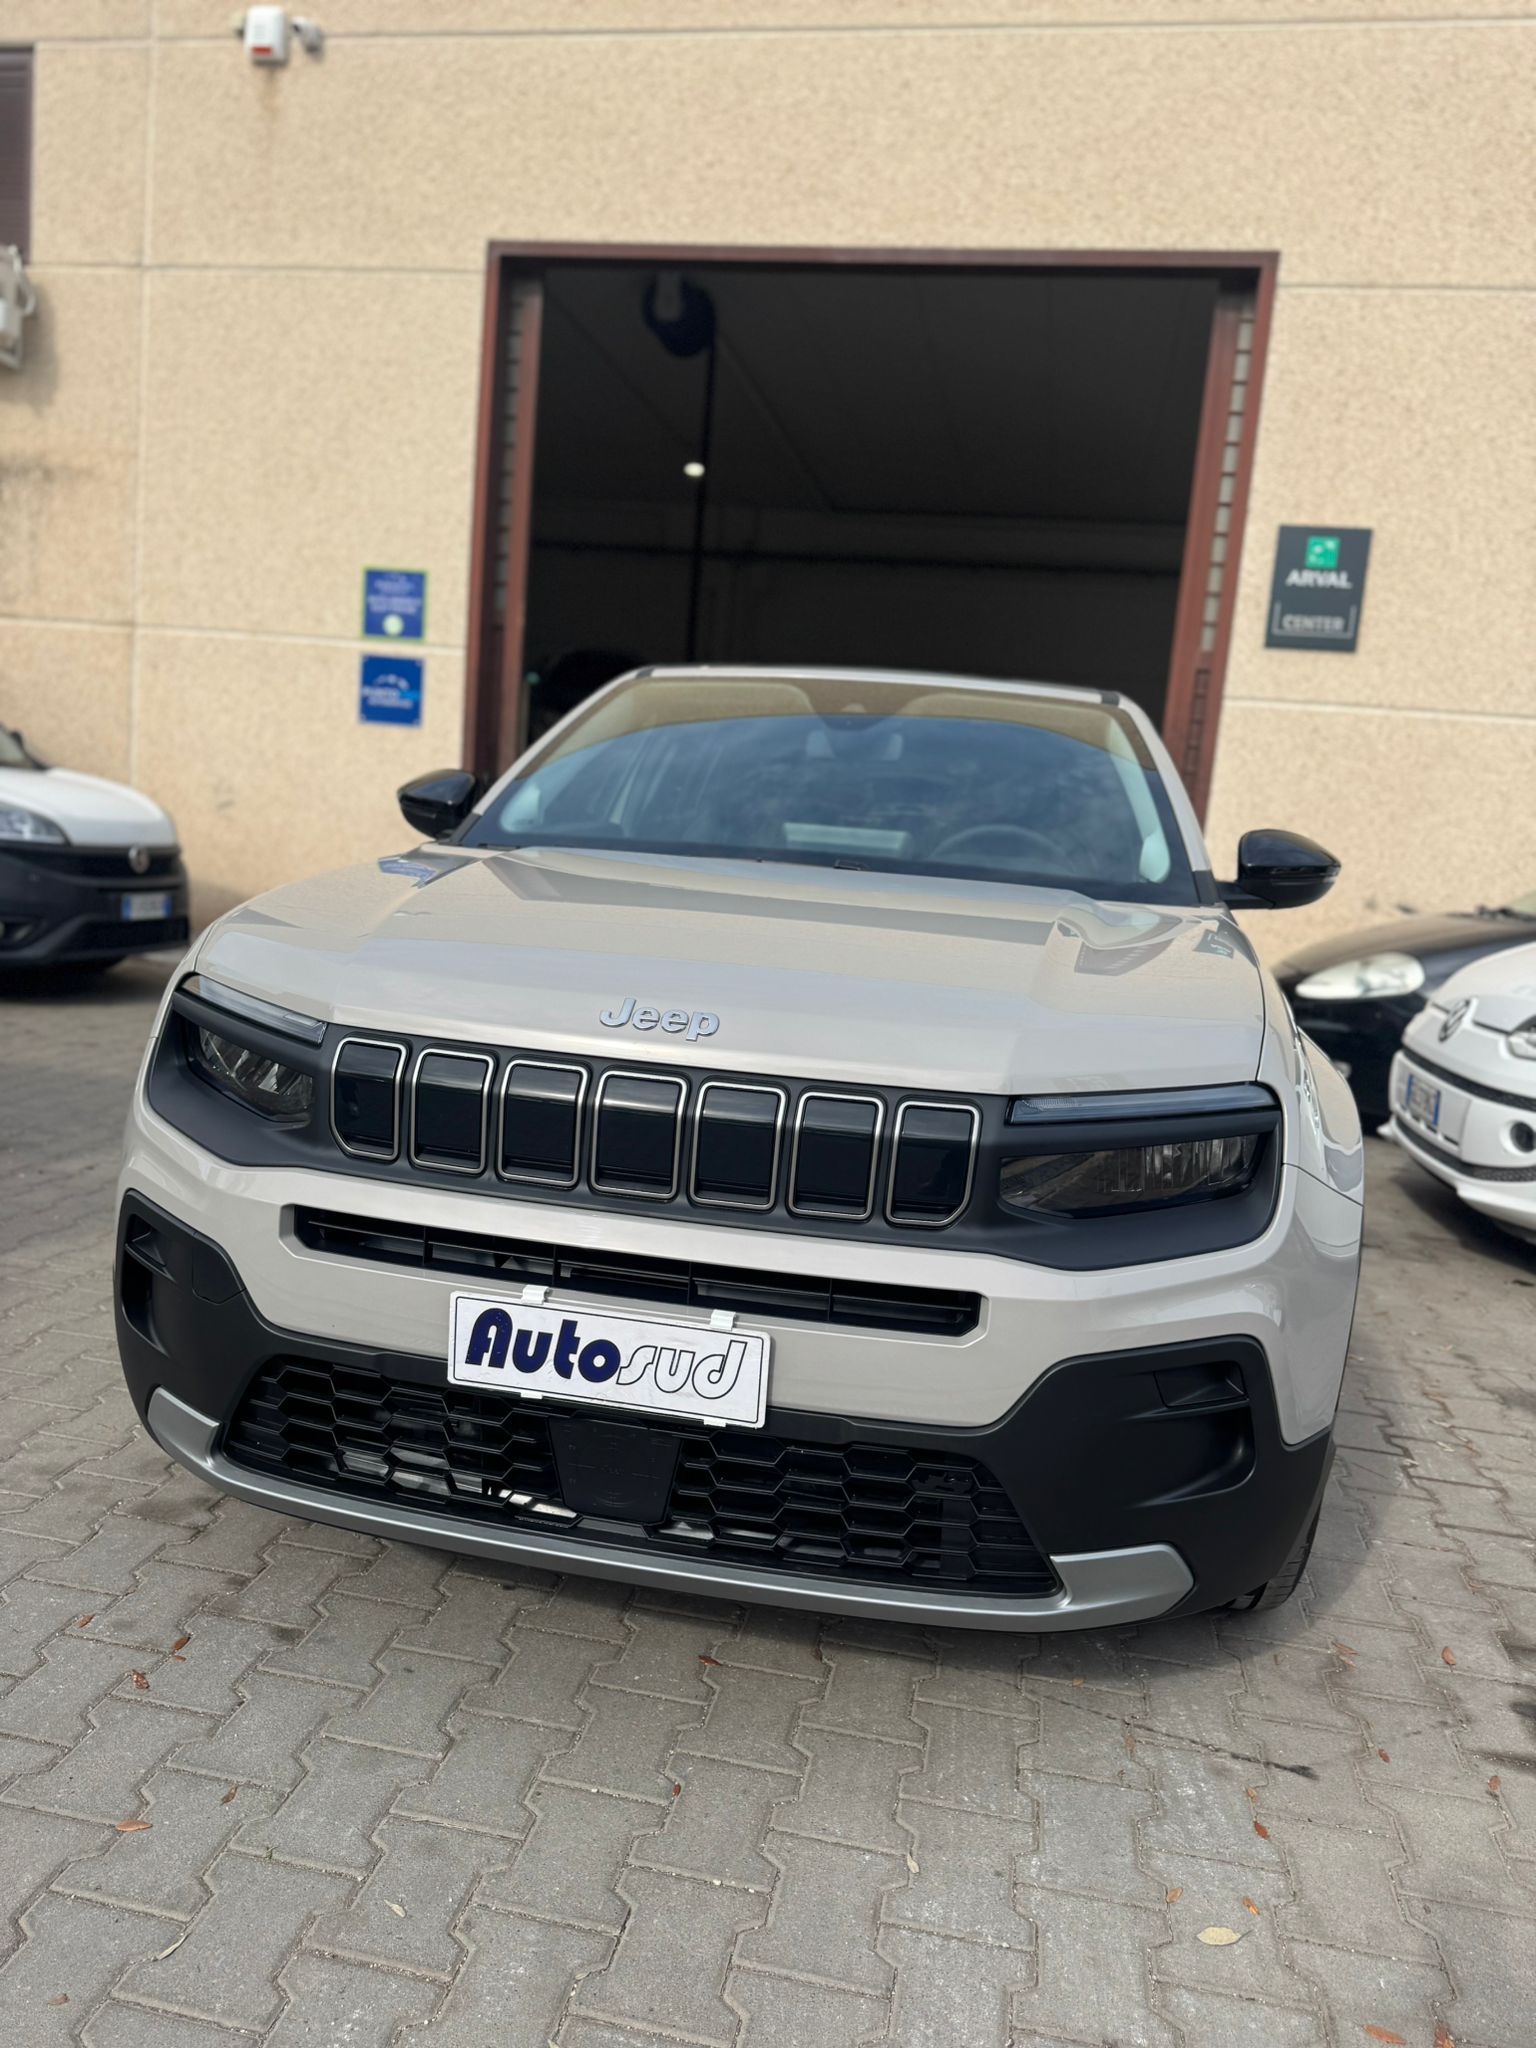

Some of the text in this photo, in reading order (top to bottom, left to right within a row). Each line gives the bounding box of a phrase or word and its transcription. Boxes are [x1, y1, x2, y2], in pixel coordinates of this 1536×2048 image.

[1285, 569, 1353, 589] ARVAL
[1281, 614, 1345, 632] CENTER
[599, 997, 720, 1042] Jeep
